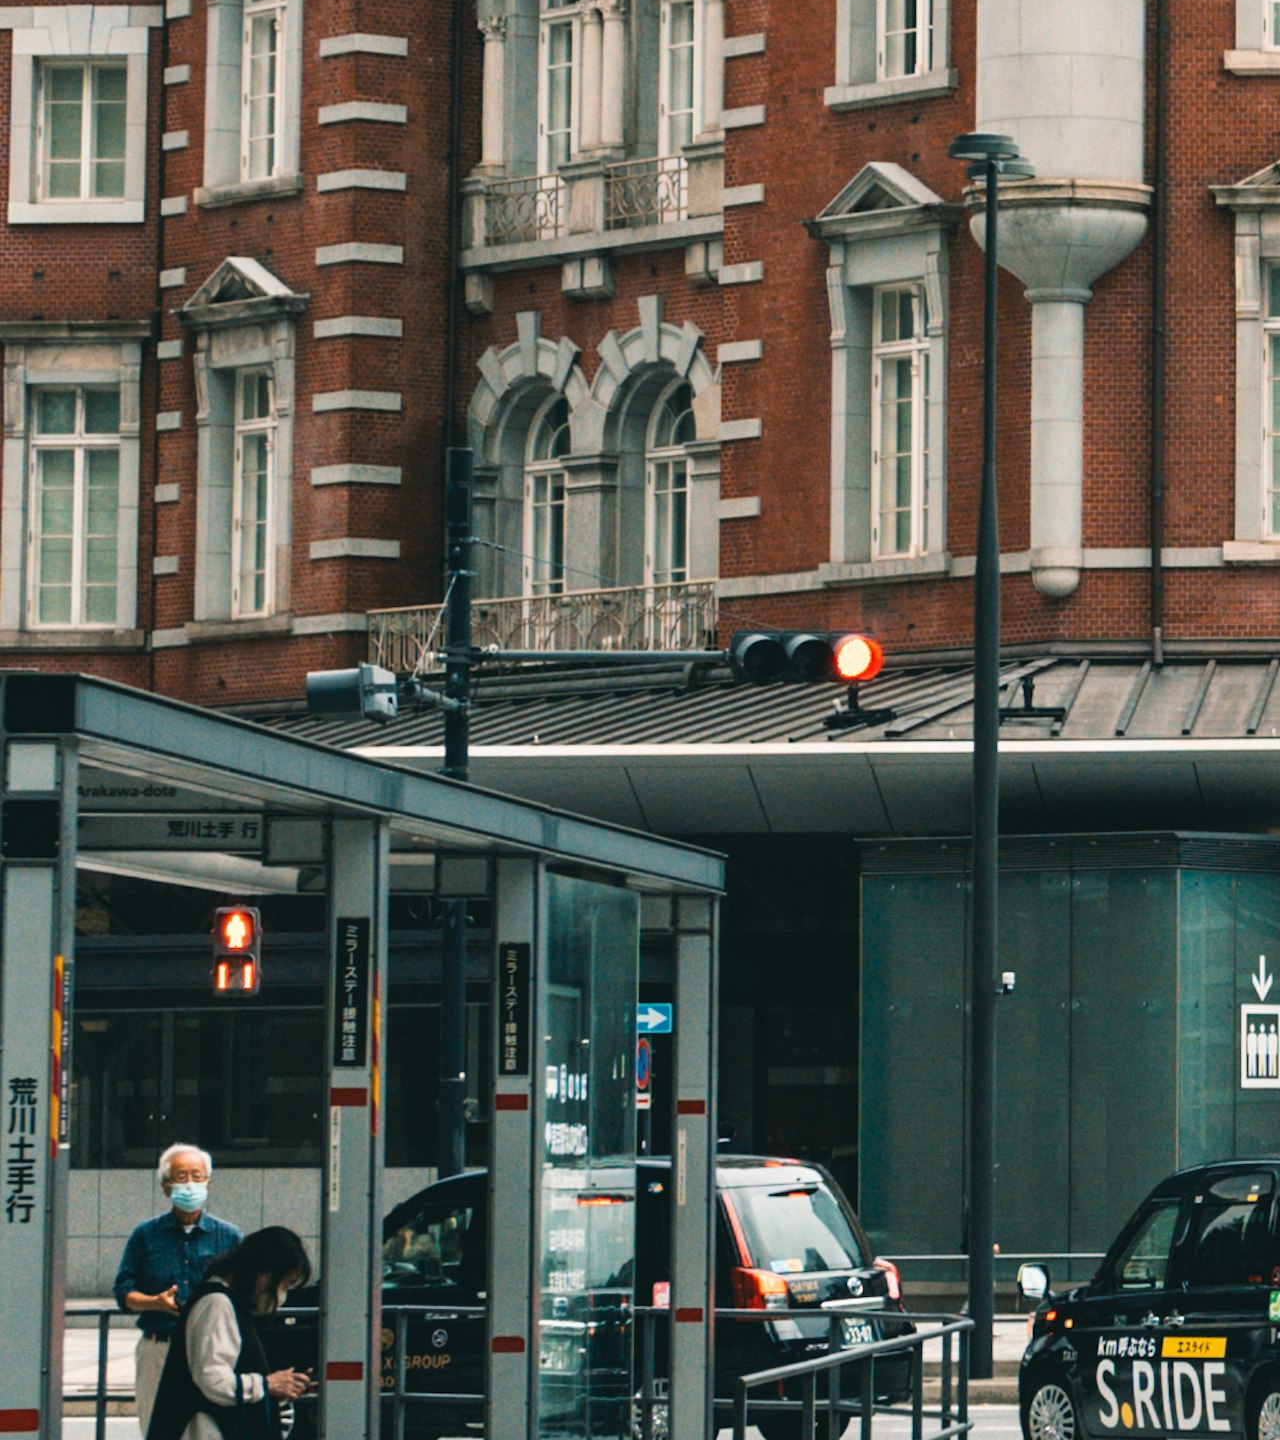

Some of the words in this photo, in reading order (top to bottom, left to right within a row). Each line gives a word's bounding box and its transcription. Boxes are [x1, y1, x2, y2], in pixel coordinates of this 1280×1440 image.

[167, 820, 235, 839] 荒川土手
[6, 1077, 38, 1224] 荒川土手行
[1097, 1335, 1157, 1358] km呼ぶなら
[1096, 1359, 1231, 1431] S.RIDE
